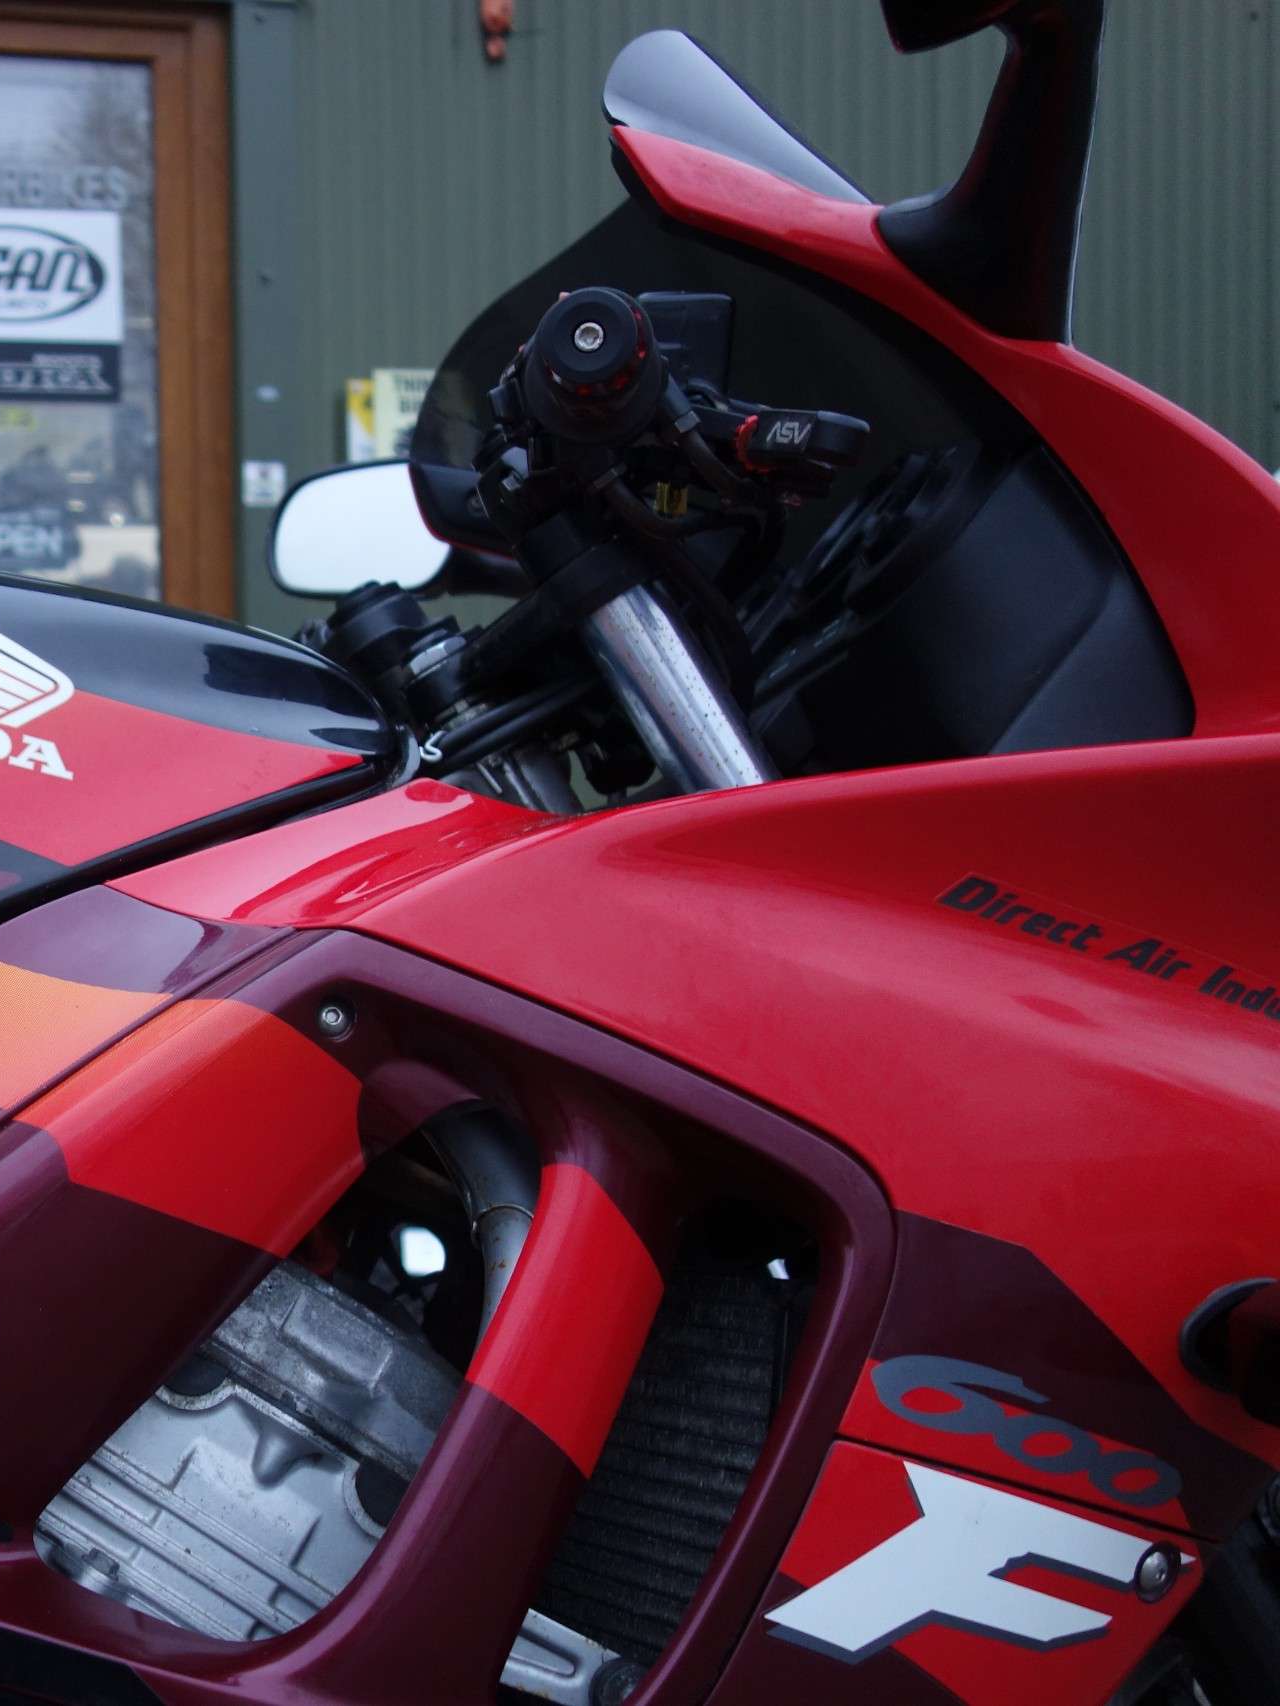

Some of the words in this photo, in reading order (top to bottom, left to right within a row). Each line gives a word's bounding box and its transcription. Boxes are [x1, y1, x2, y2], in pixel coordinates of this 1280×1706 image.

[766, 421, 812, 444] ASV
[936, 875, 1105, 952] Direct
[1103, 936, 1193, 981] Air
[870, 1354, 1183, 1507] 600
[763, 1461, 1197, 1664] F
